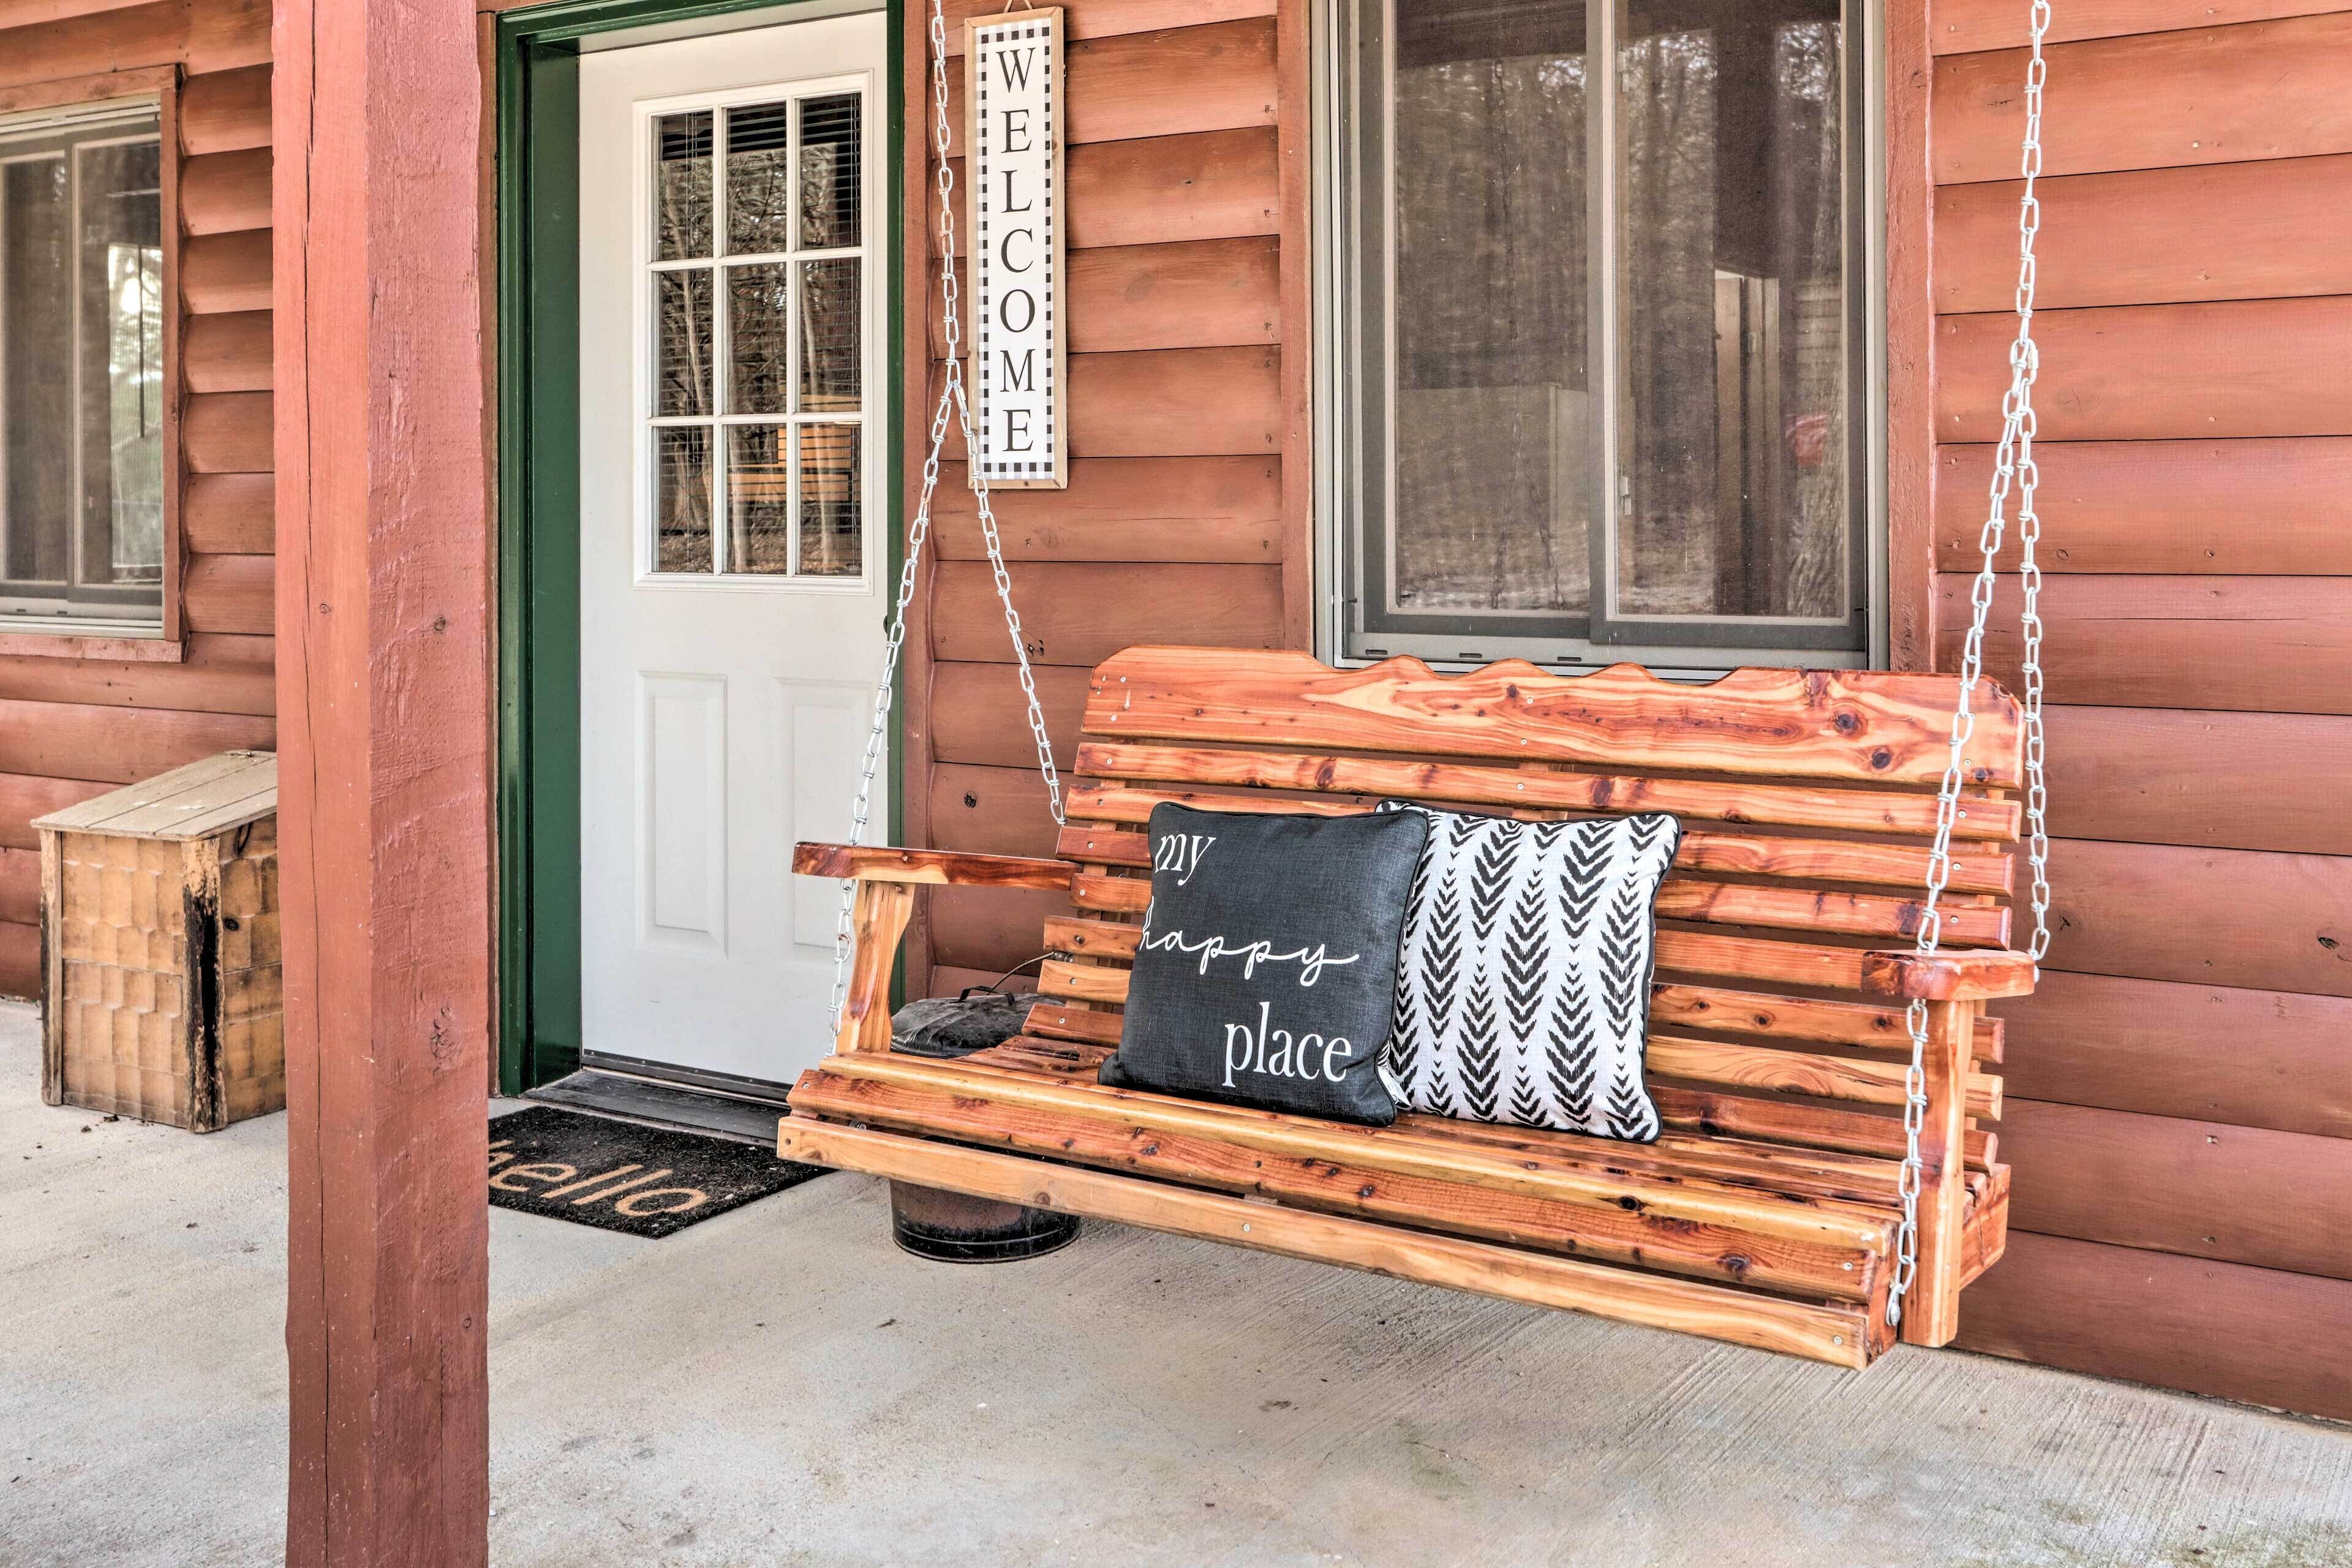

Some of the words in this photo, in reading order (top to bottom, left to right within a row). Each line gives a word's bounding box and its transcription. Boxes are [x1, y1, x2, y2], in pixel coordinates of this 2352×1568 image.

[996, 47, 1036, 452] WELCOME
[1155, 833, 1216, 886] my
[1221, 1001, 1352, 1088] place
